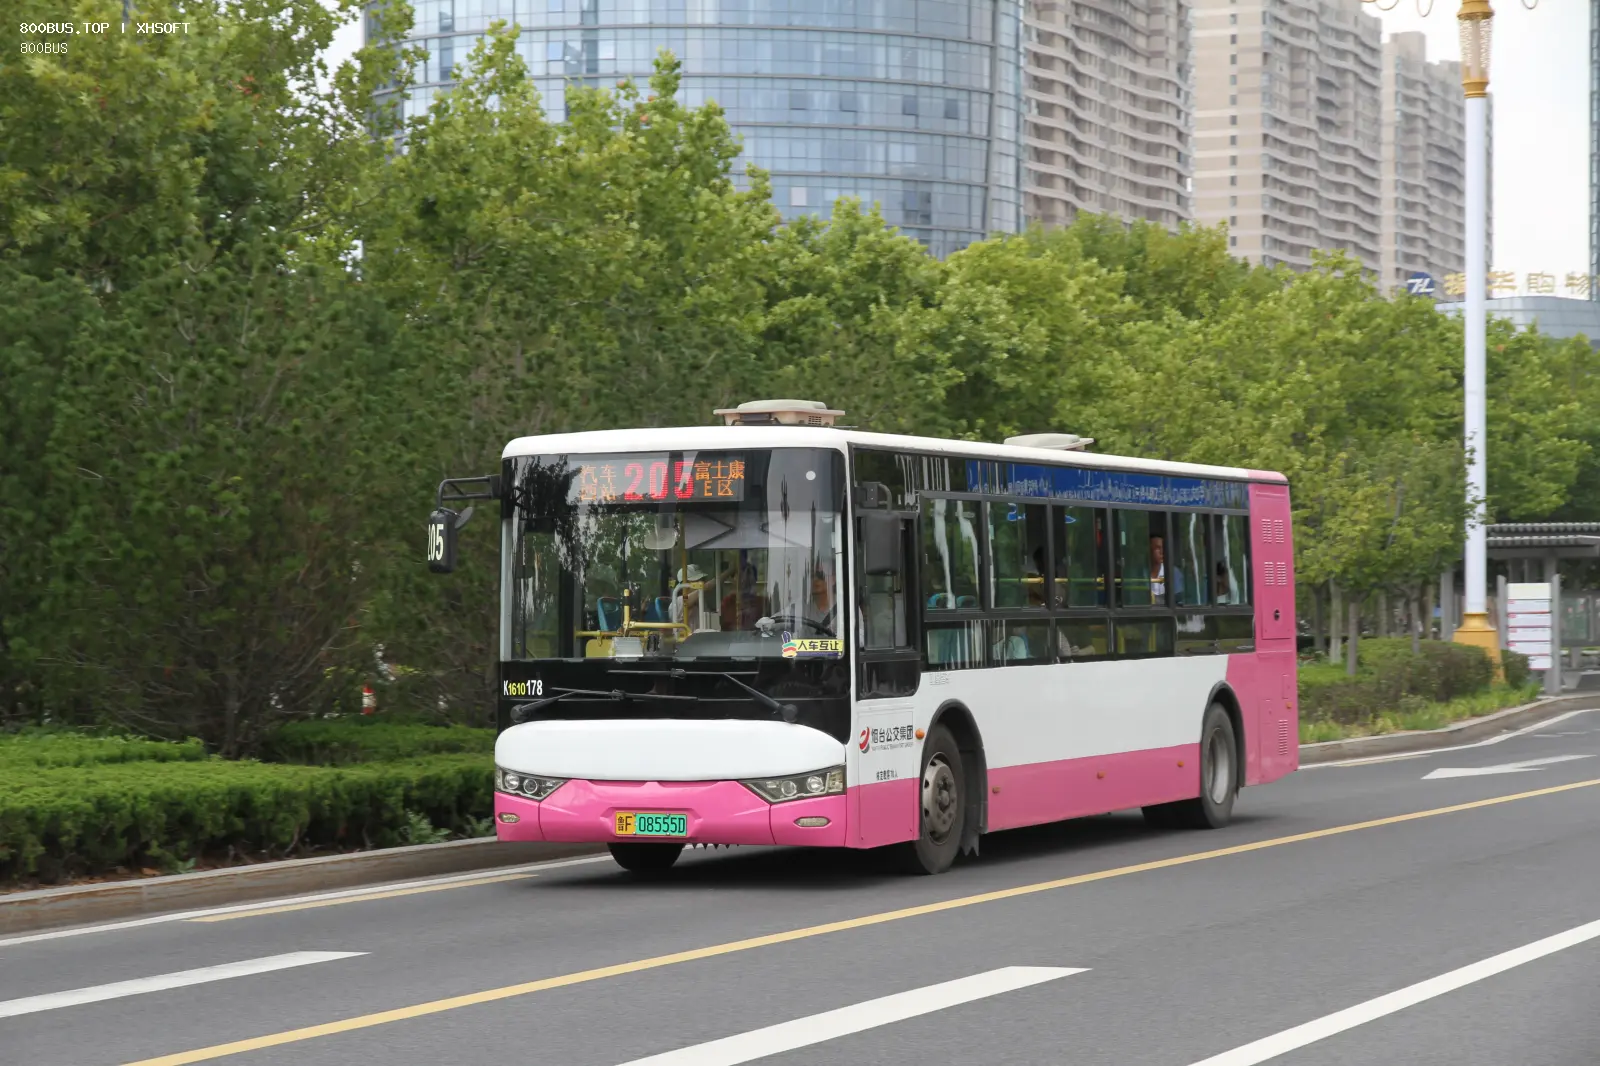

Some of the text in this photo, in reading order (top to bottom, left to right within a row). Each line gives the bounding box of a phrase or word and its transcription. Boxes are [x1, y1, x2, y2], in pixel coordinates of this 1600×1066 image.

[580, 464, 617, 484] 汽车
[694, 460, 745, 480] 富士康
[624, 461, 695, 501] 205
[704, 479, 734, 497] E区
[797, 640, 839, 651] 人车互让
[871, 724, 914, 744] 烟台公交集团
